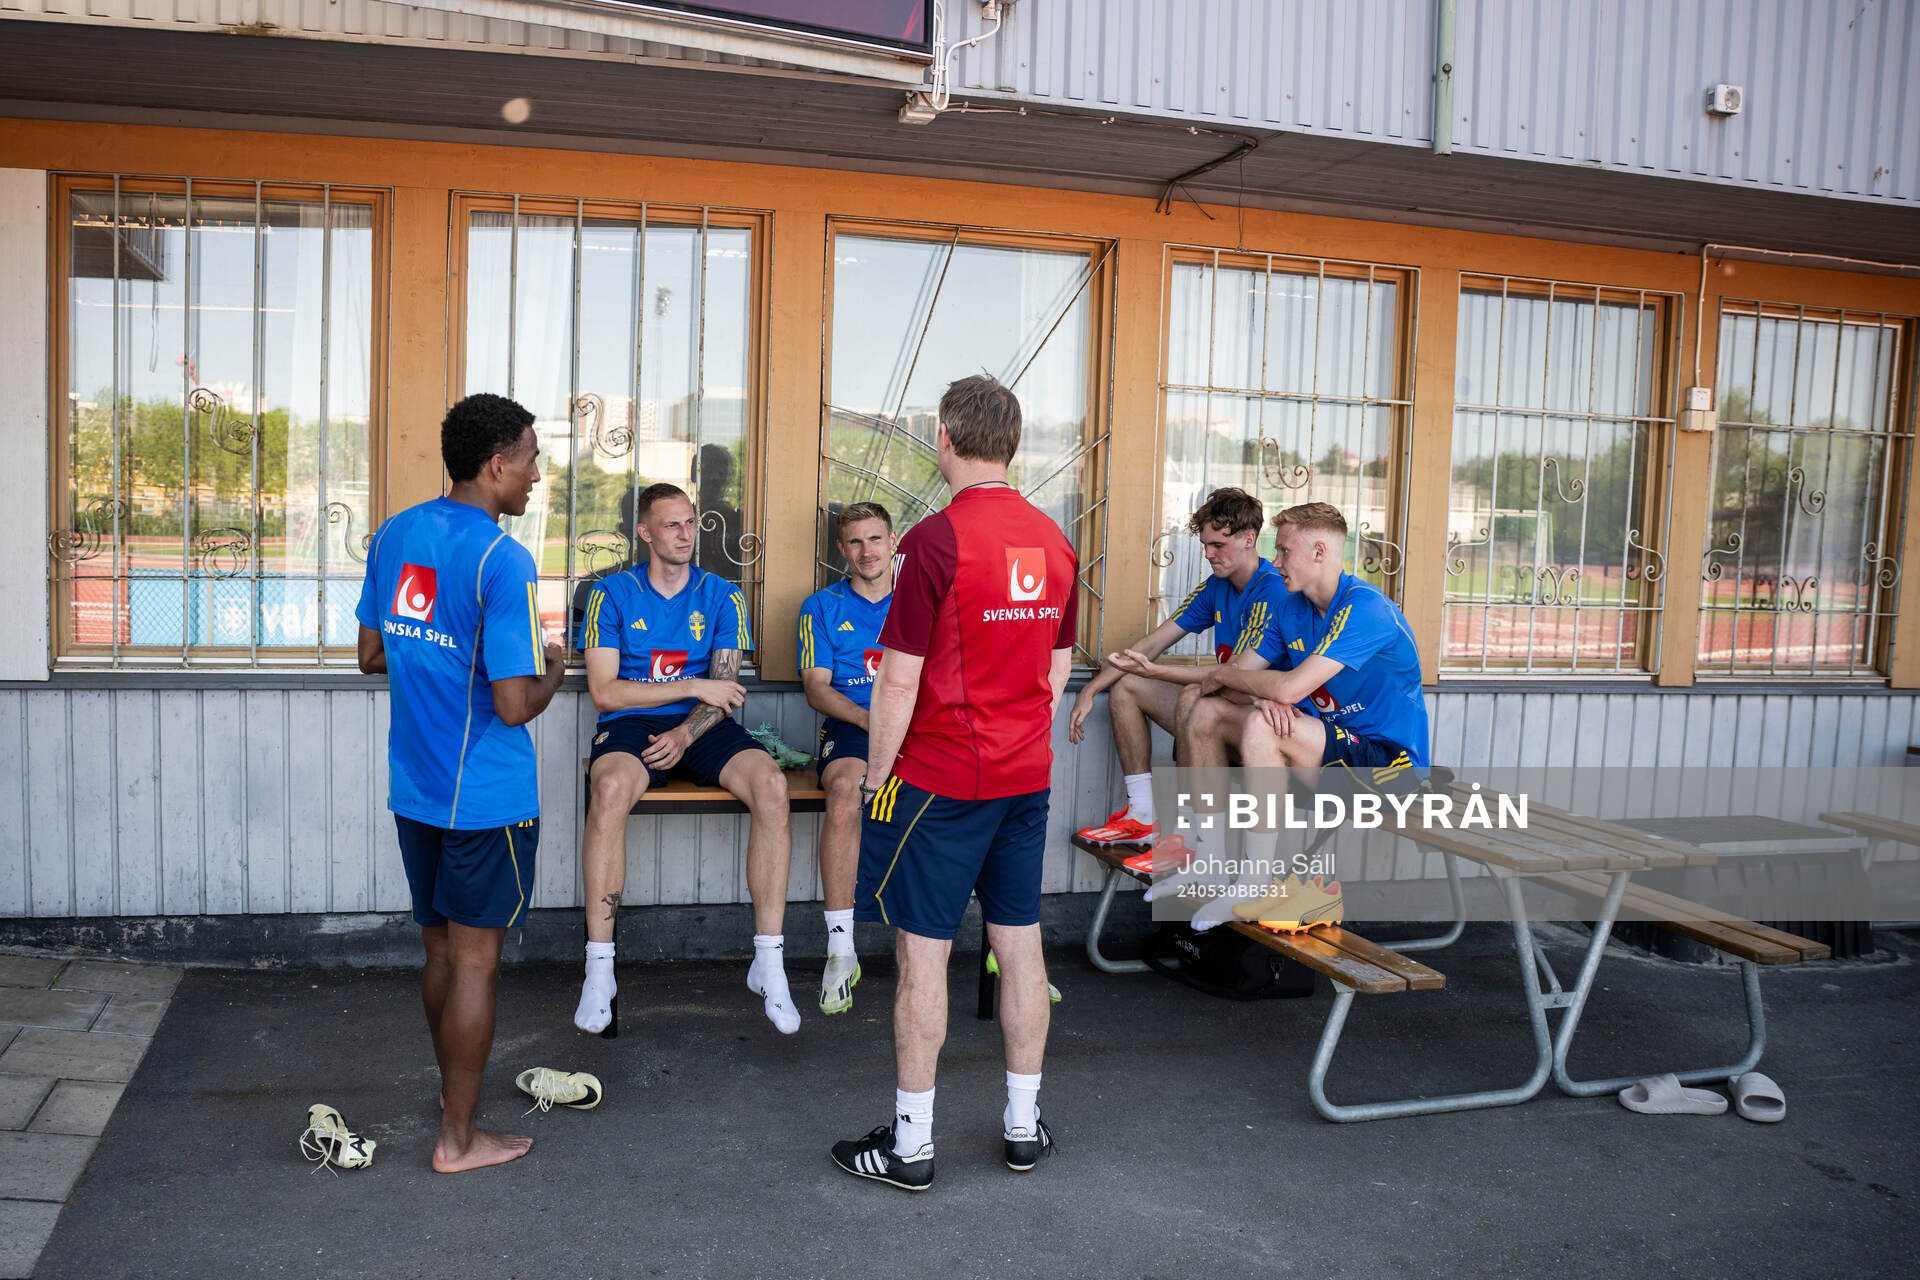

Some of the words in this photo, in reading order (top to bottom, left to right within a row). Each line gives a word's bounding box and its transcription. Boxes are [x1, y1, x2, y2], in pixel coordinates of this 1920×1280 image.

[983, 607, 1035, 622] SVENSKA
[1037, 607, 1060, 619] SPEL
[425, 628, 457, 648] SPEL
[847, 676, 876, 686] SVEN
